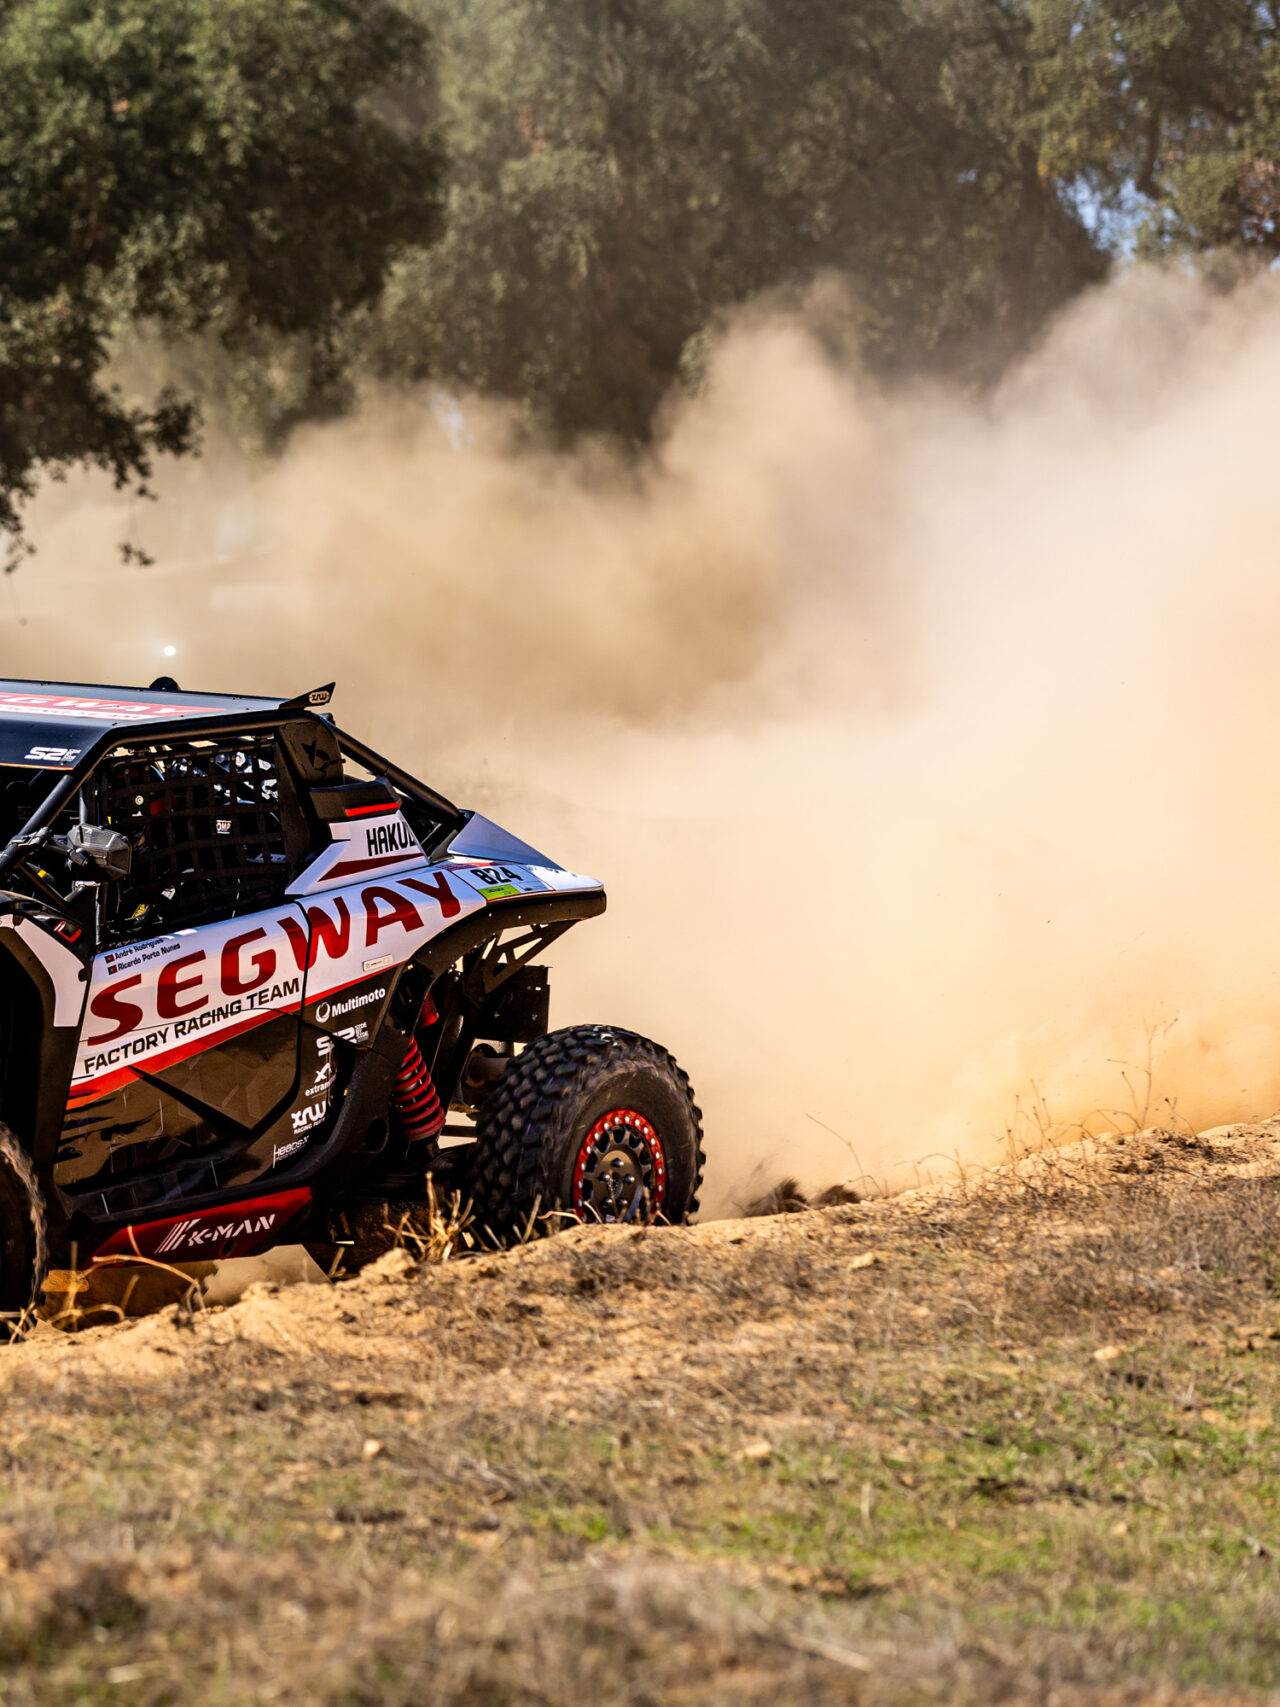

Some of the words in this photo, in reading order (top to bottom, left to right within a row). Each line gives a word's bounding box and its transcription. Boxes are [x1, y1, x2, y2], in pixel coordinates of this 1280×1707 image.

[470, 866, 523, 885] 824
[87, 871, 461, 1046] SEGWAY
[117, 957, 141, 971] Ricardo
[142, 950, 160, 962] Porto
[160, 943, 181, 955] Nunes
[331, 987, 386, 1017] Multimoto
[84, 1027, 169, 1074] FACTORY
[174, 999, 242, 1039] RACING
[246, 977, 300, 1010] TEAM
[187, 1213, 276, 1247] K-MAN
